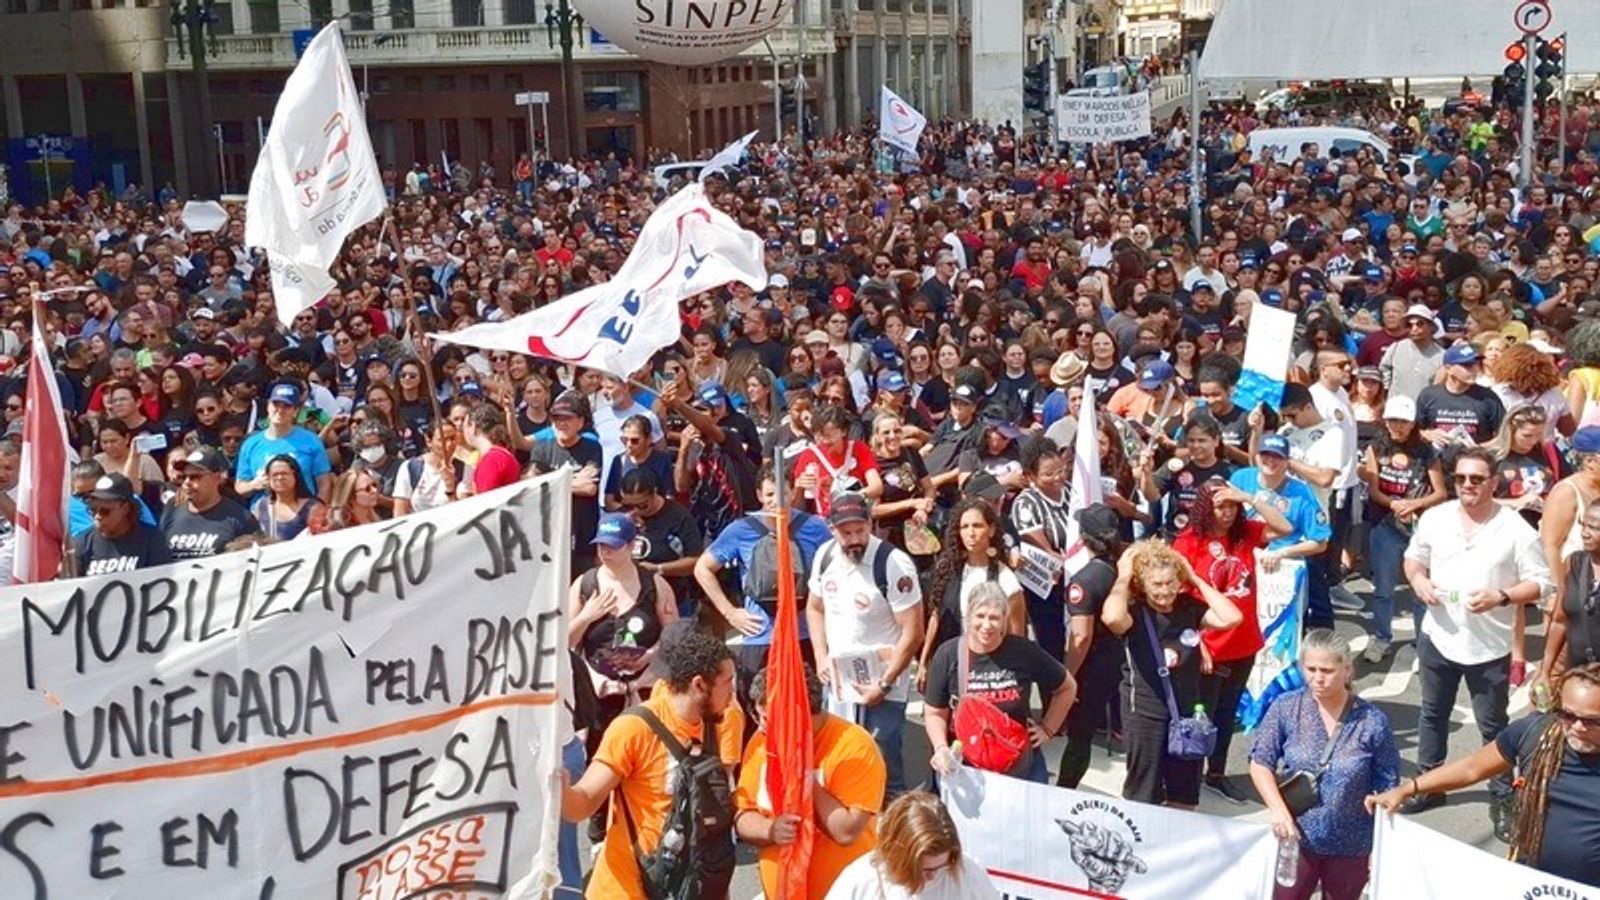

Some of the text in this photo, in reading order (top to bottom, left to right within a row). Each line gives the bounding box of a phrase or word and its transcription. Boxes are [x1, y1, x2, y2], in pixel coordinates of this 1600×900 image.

[169, 532, 219, 550] SEDIN
[365, 644, 451, 706] PELA
[461, 609, 563, 708] BASE
[160, 807, 239, 870] EM
[283, 716, 519, 863] DEFESA
